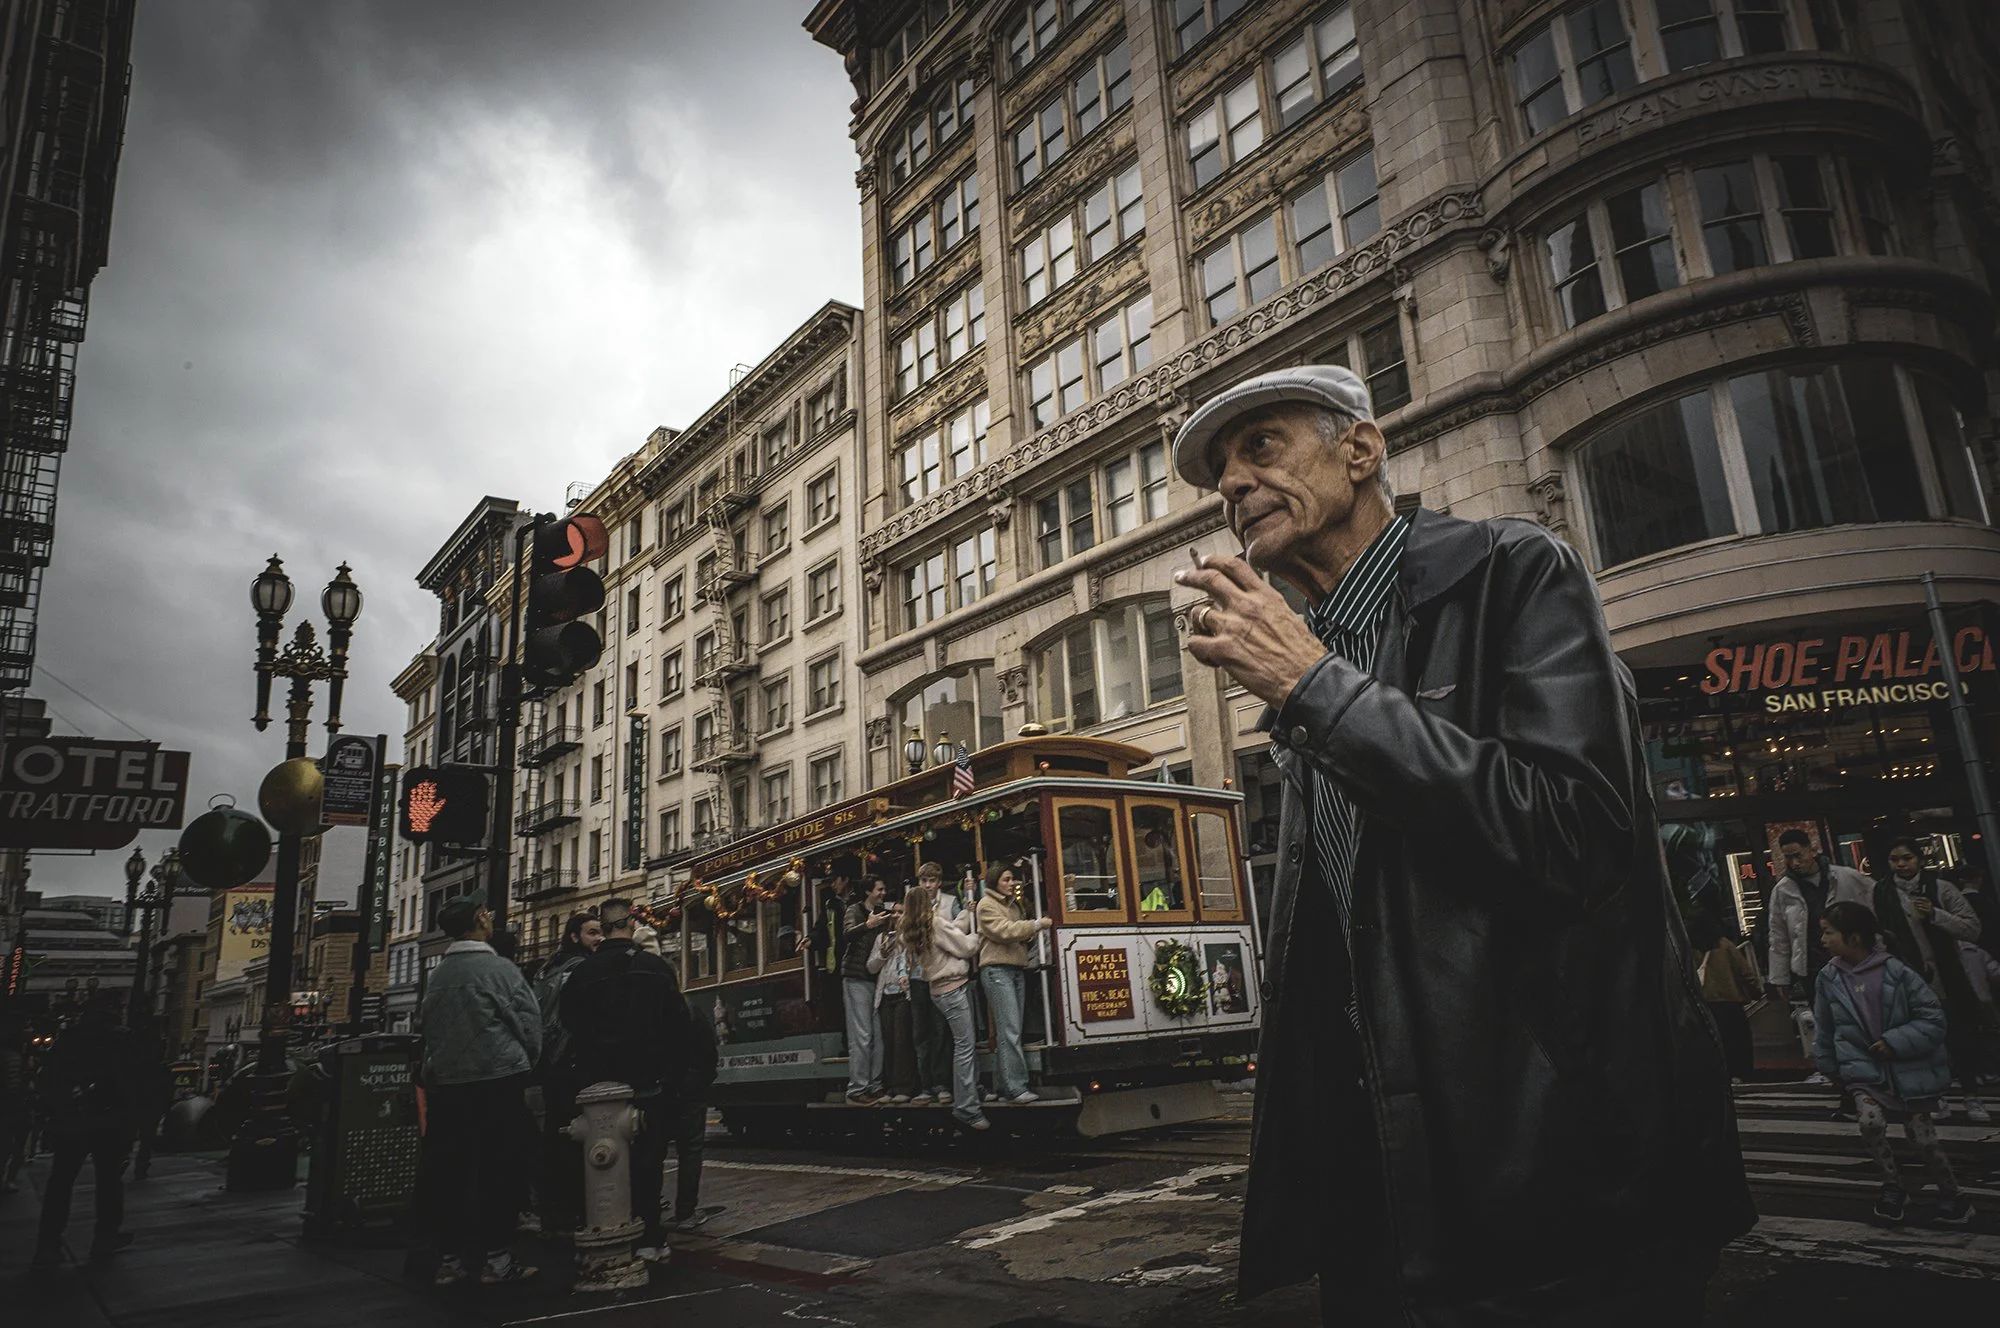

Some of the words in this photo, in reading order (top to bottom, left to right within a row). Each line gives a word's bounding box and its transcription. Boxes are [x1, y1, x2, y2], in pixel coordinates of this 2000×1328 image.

[1578, 89, 1682, 146] ELKAN
[1701, 638, 1824, 696] SHOE
[1764, 691, 1815, 714] SAN
[380, 789, 390, 828] THE
[632, 774, 641, 842] BARNES
[704, 844, 759, 873] POWELL
[766, 839, 776, 851] &
[784, 819, 825, 844] HYDE
[834, 810, 857, 826] Sts.
[372, 836, 388, 925] BARNES
[1078, 953, 1126, 965] POWELL
[1079, 969, 1128, 981] MARKET
[1092, 962, 1116, 971] AND
[369, 1063, 407, 1073] UNION
